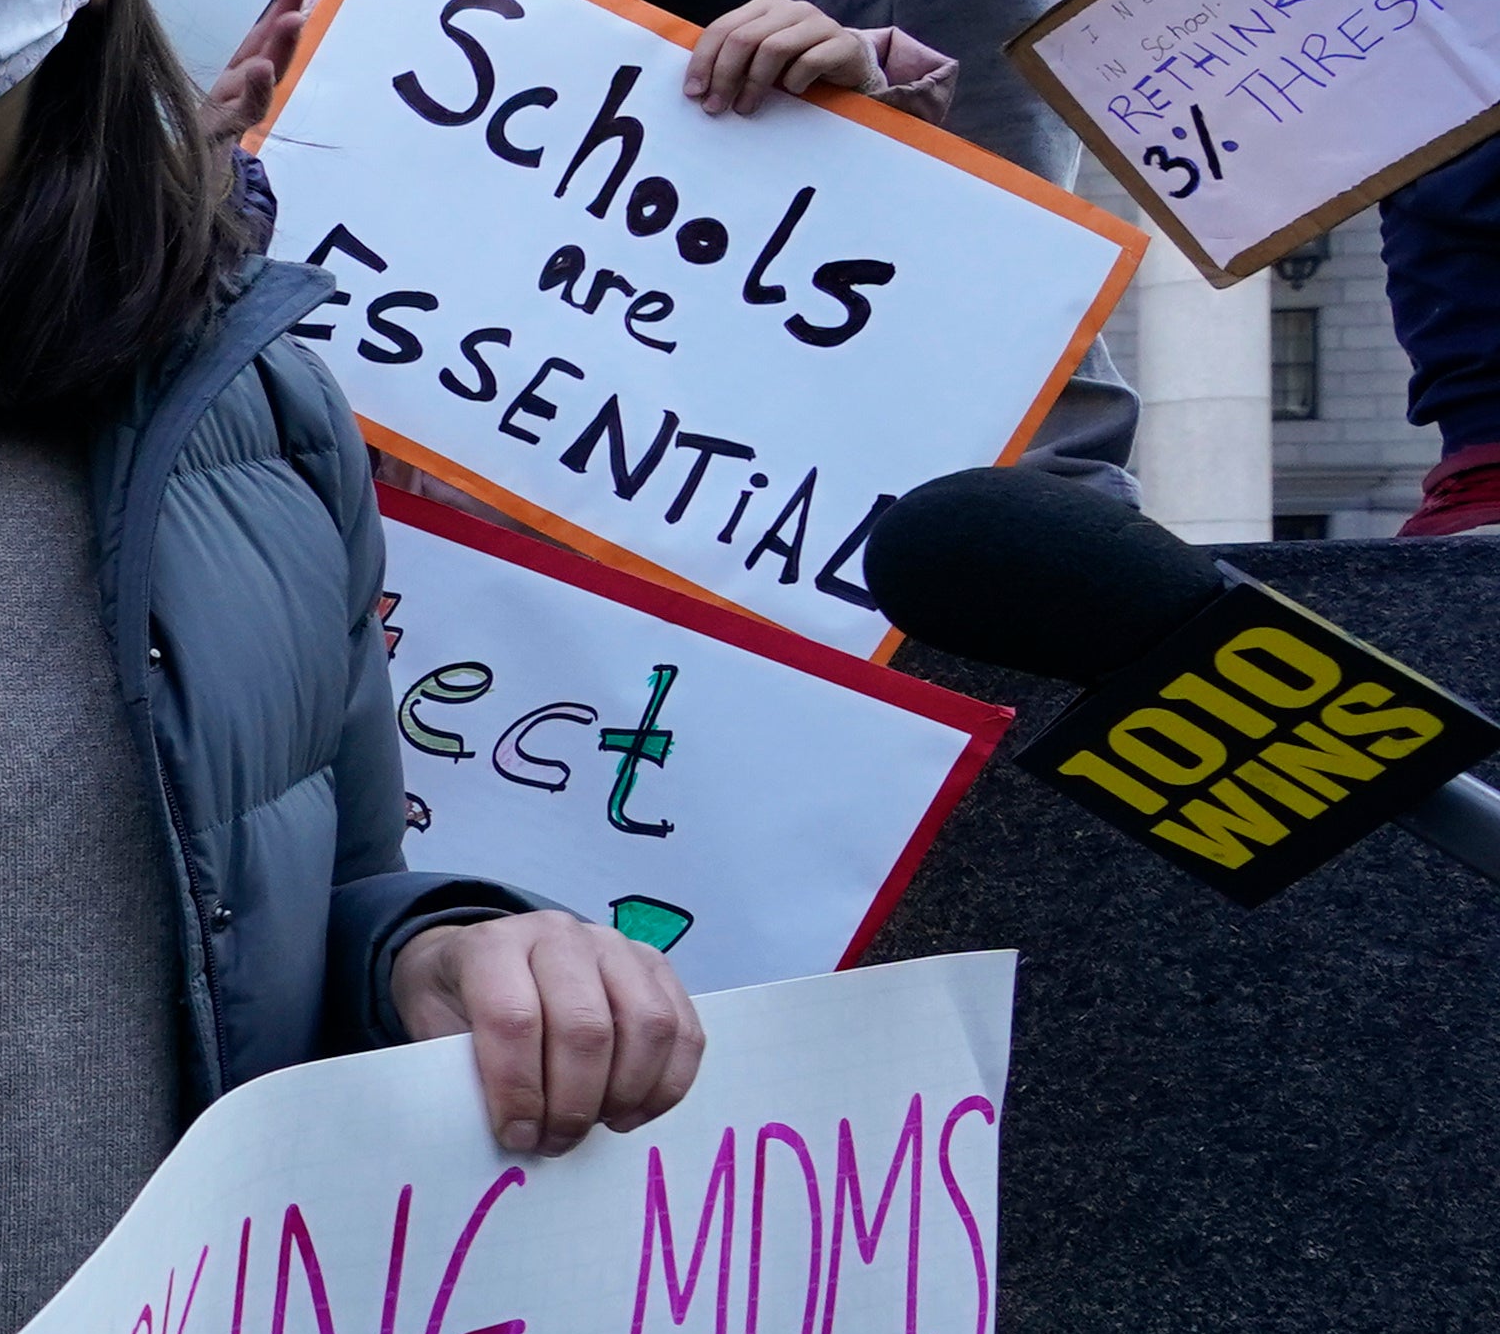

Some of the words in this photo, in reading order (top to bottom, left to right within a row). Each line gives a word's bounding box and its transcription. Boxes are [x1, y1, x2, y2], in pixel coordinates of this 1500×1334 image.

[1142, 103, 1240, 200] 3%
[539, 243, 677, 355] are
[1056, 626, 1342, 815] 1010
[1149, 681, 1445, 870] WINS
